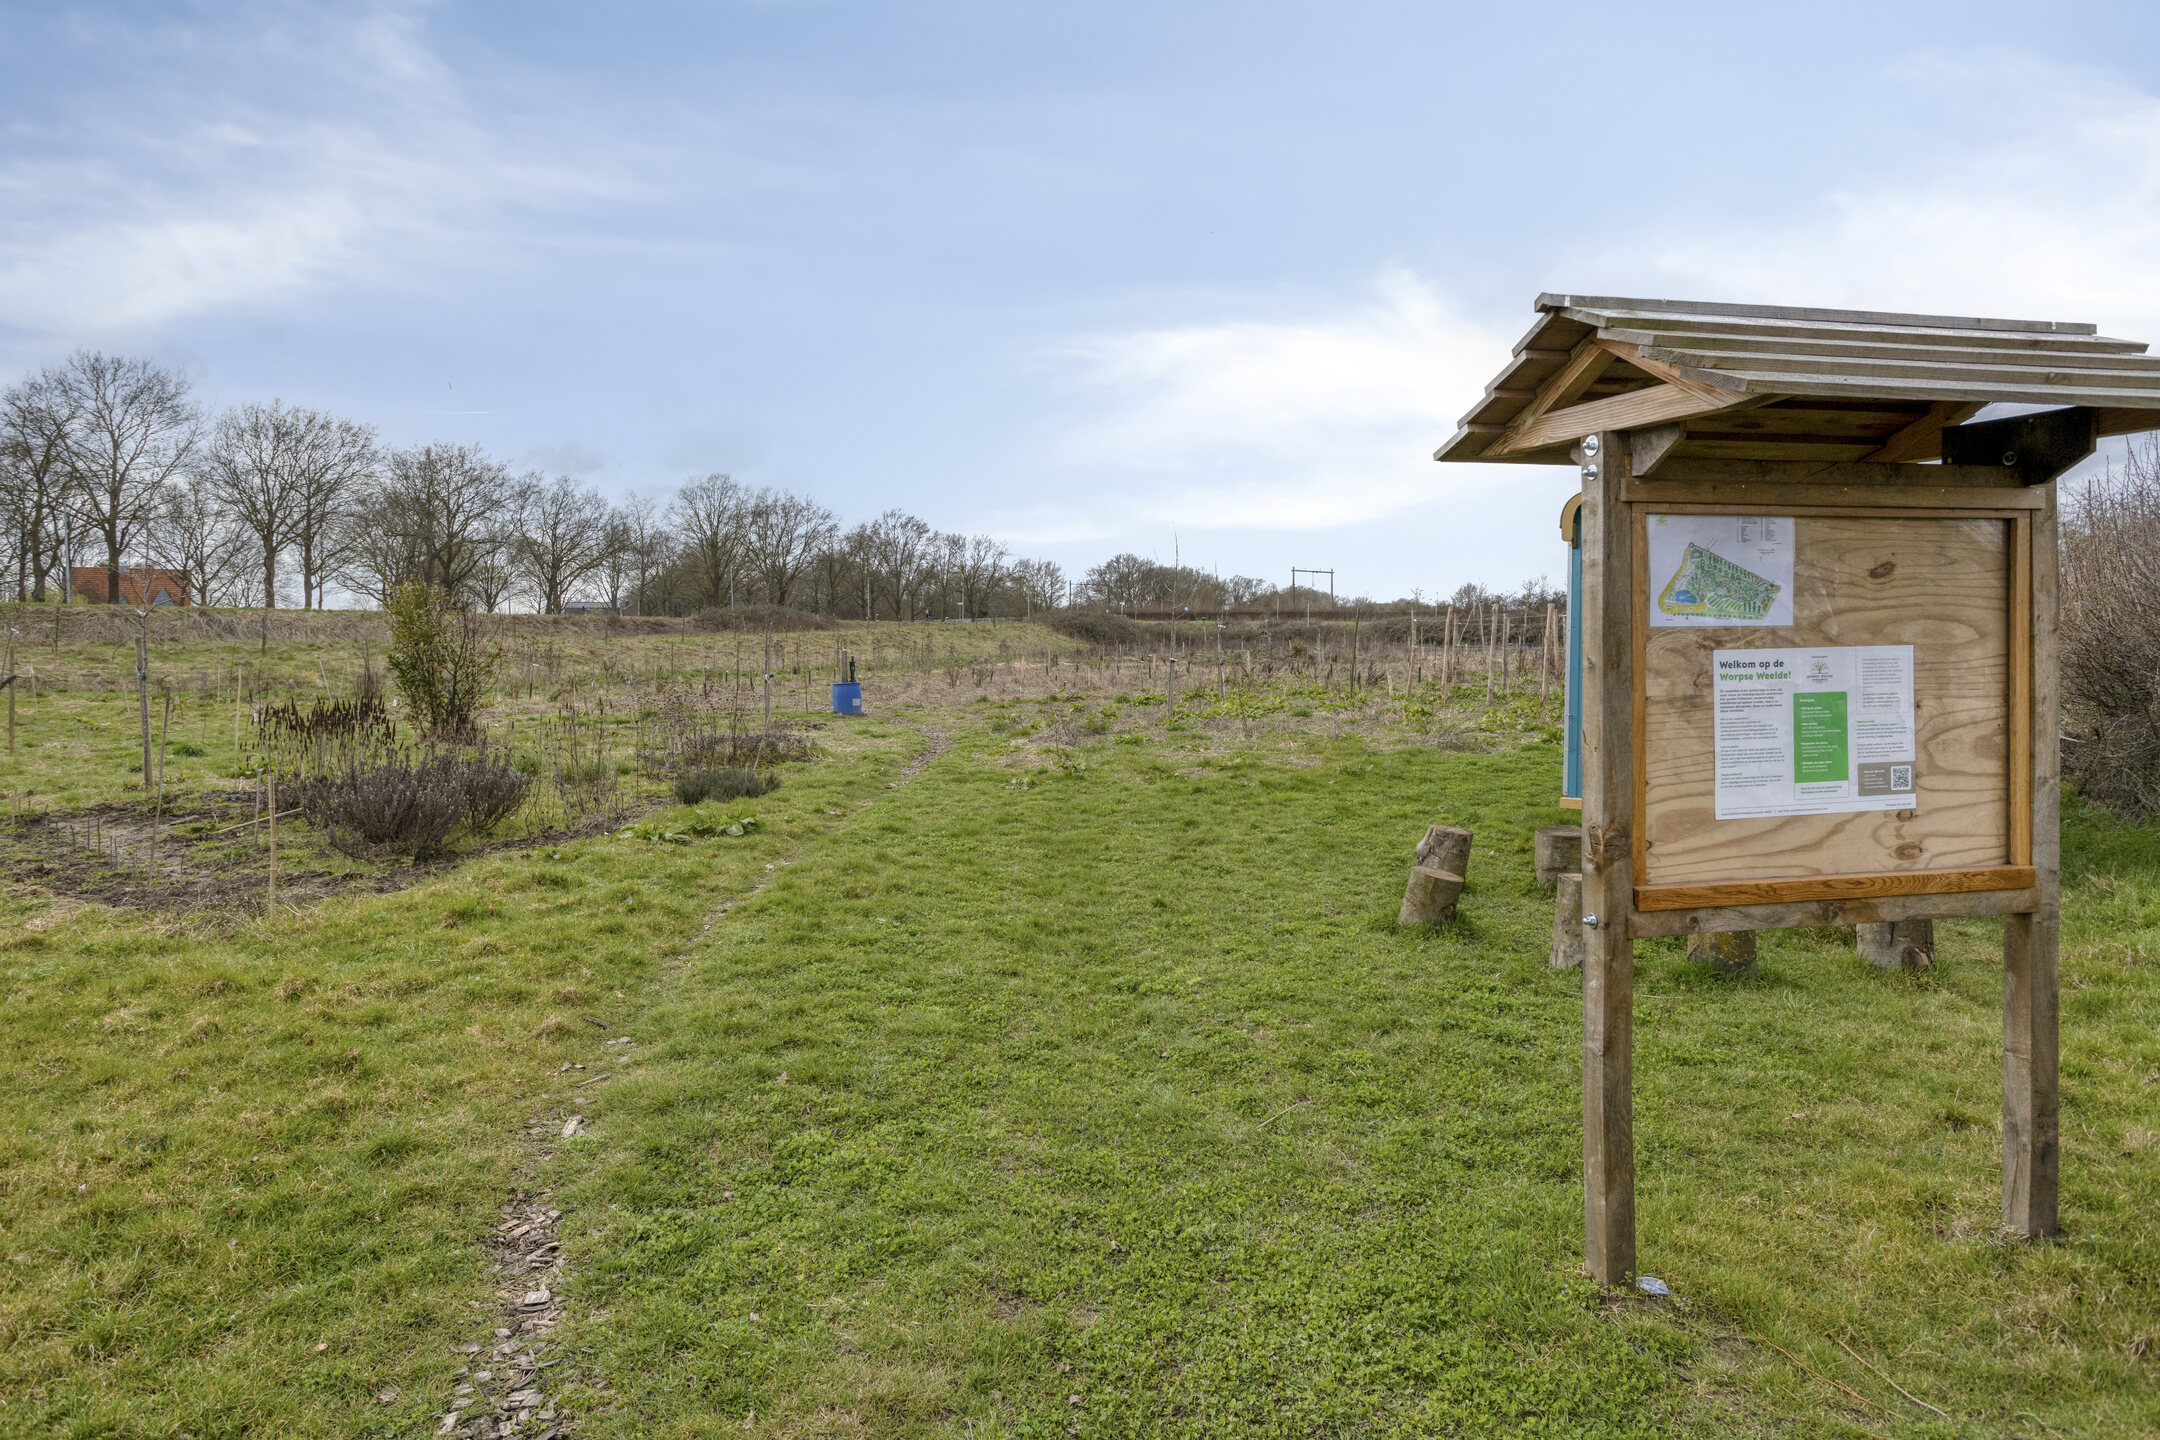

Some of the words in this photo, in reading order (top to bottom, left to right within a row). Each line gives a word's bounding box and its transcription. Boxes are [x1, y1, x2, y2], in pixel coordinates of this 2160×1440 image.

[1719, 660, 1756, 669] Welkom
[1759, 661, 1770, 670] op
[1773, 659, 1784, 668] de
[1719, 672, 1754, 683] Worpse
[1756, 671, 1792, 680] Weelde!
